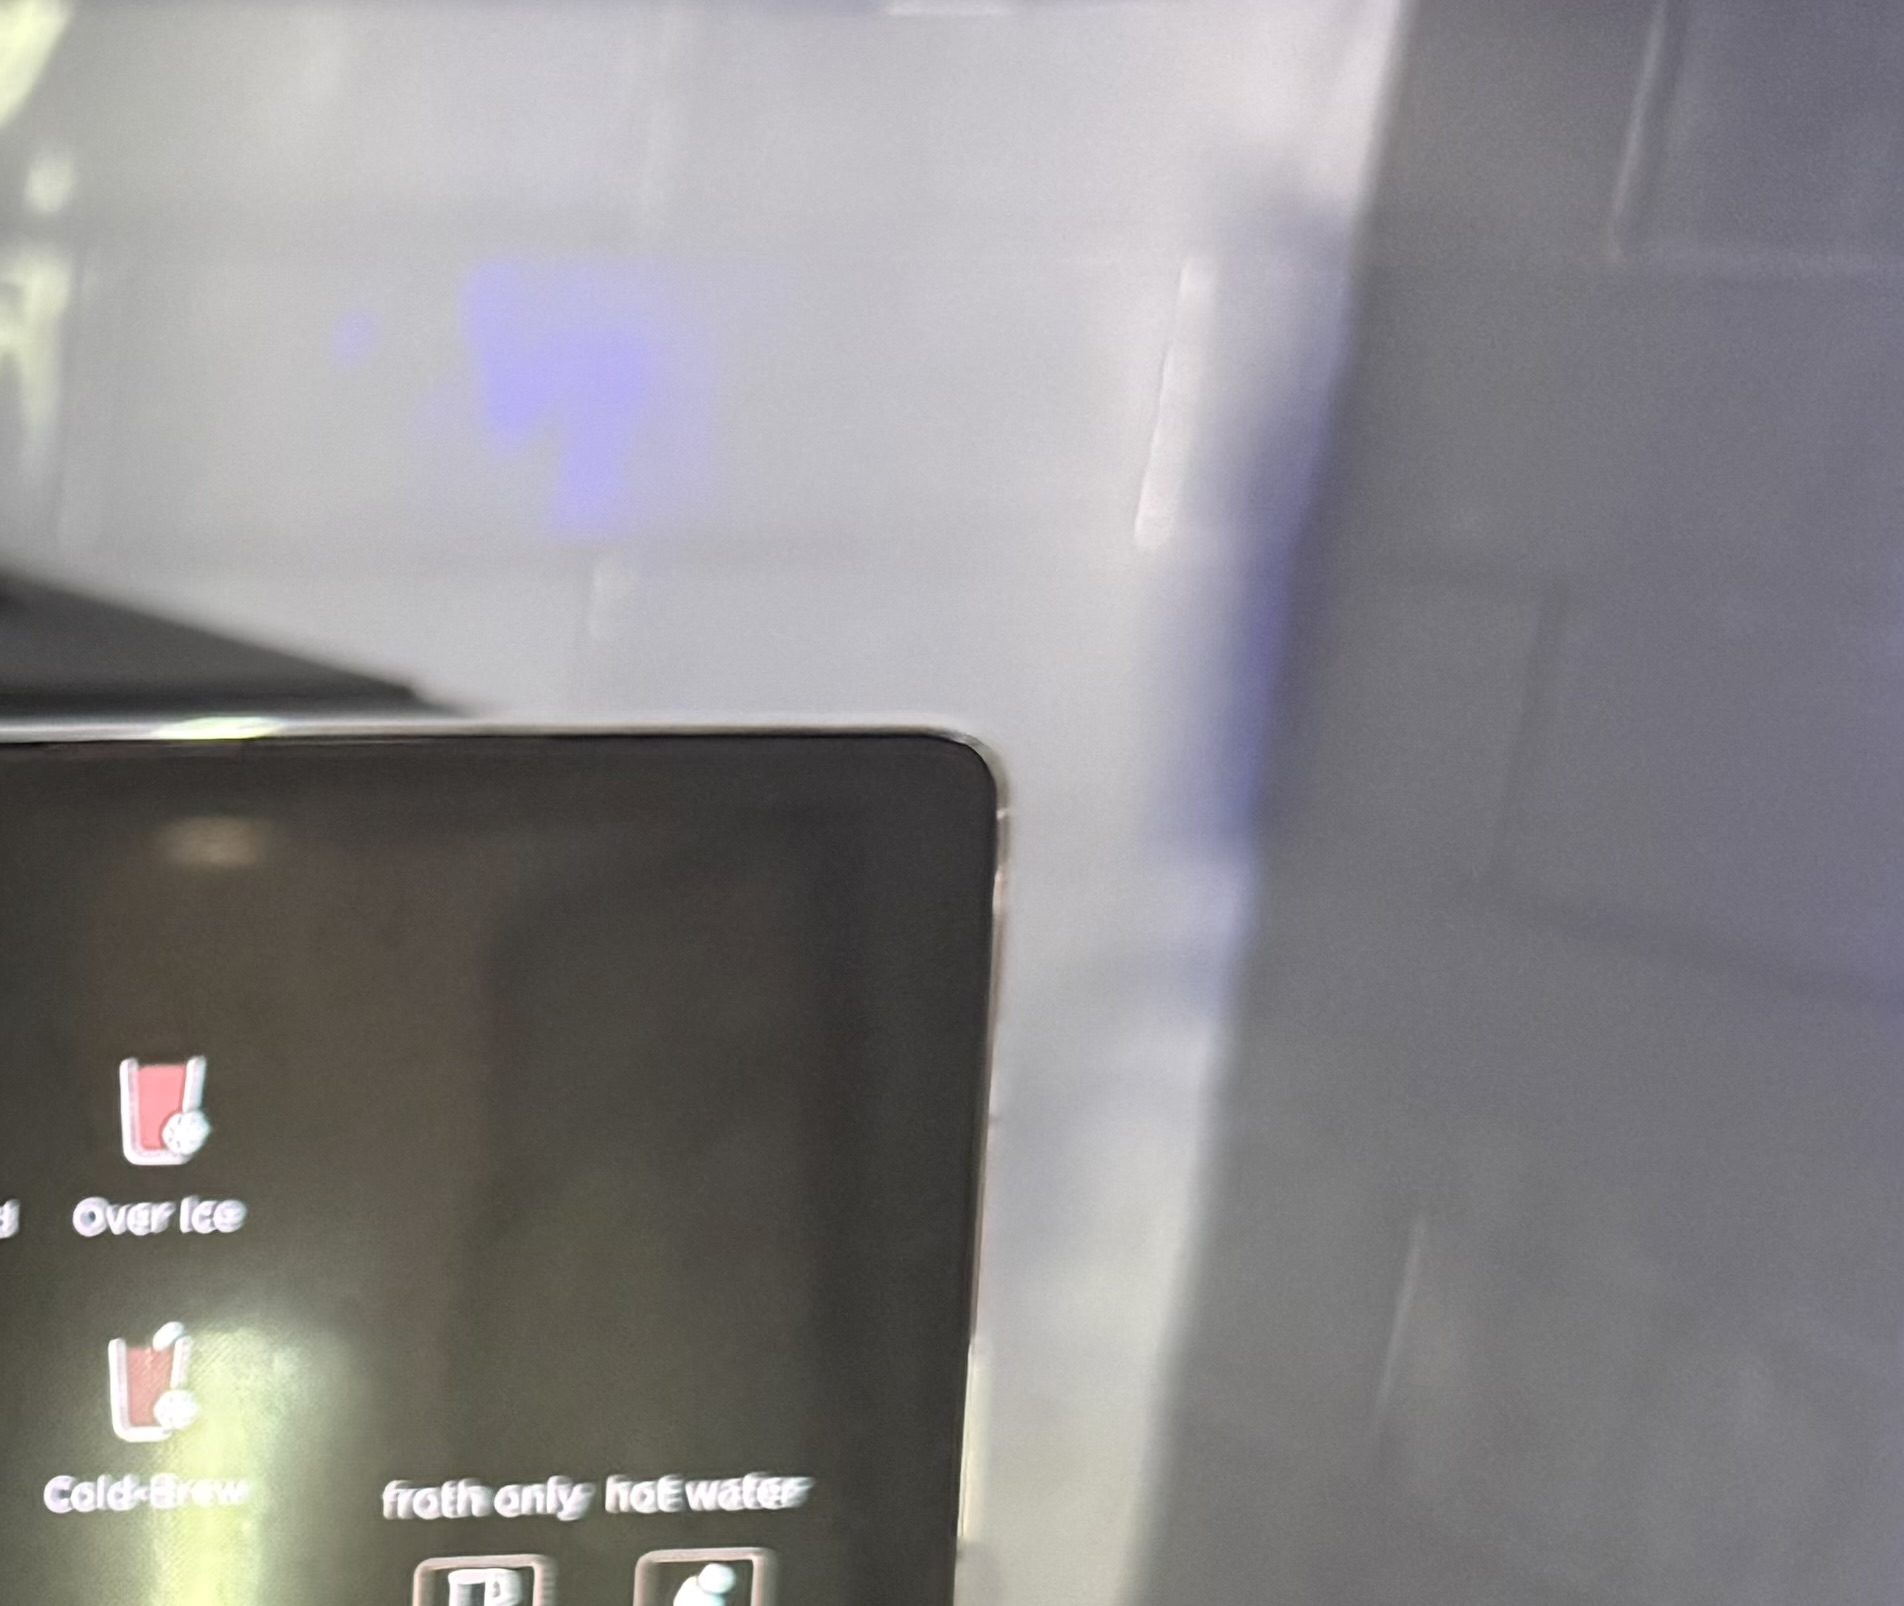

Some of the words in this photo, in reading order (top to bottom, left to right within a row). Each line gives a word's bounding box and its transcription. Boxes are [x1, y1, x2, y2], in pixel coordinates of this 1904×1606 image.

[71, 1197, 173, 1237] Over
[179, 1196, 248, 1235] Ice
[43, 1473, 249, 1514] Cold-Brew
[382, 1478, 492, 1520] froth
[493, 1474, 594, 1521] only
[604, 1474, 686, 1514] hot
[686, 1471, 813, 1511] water
